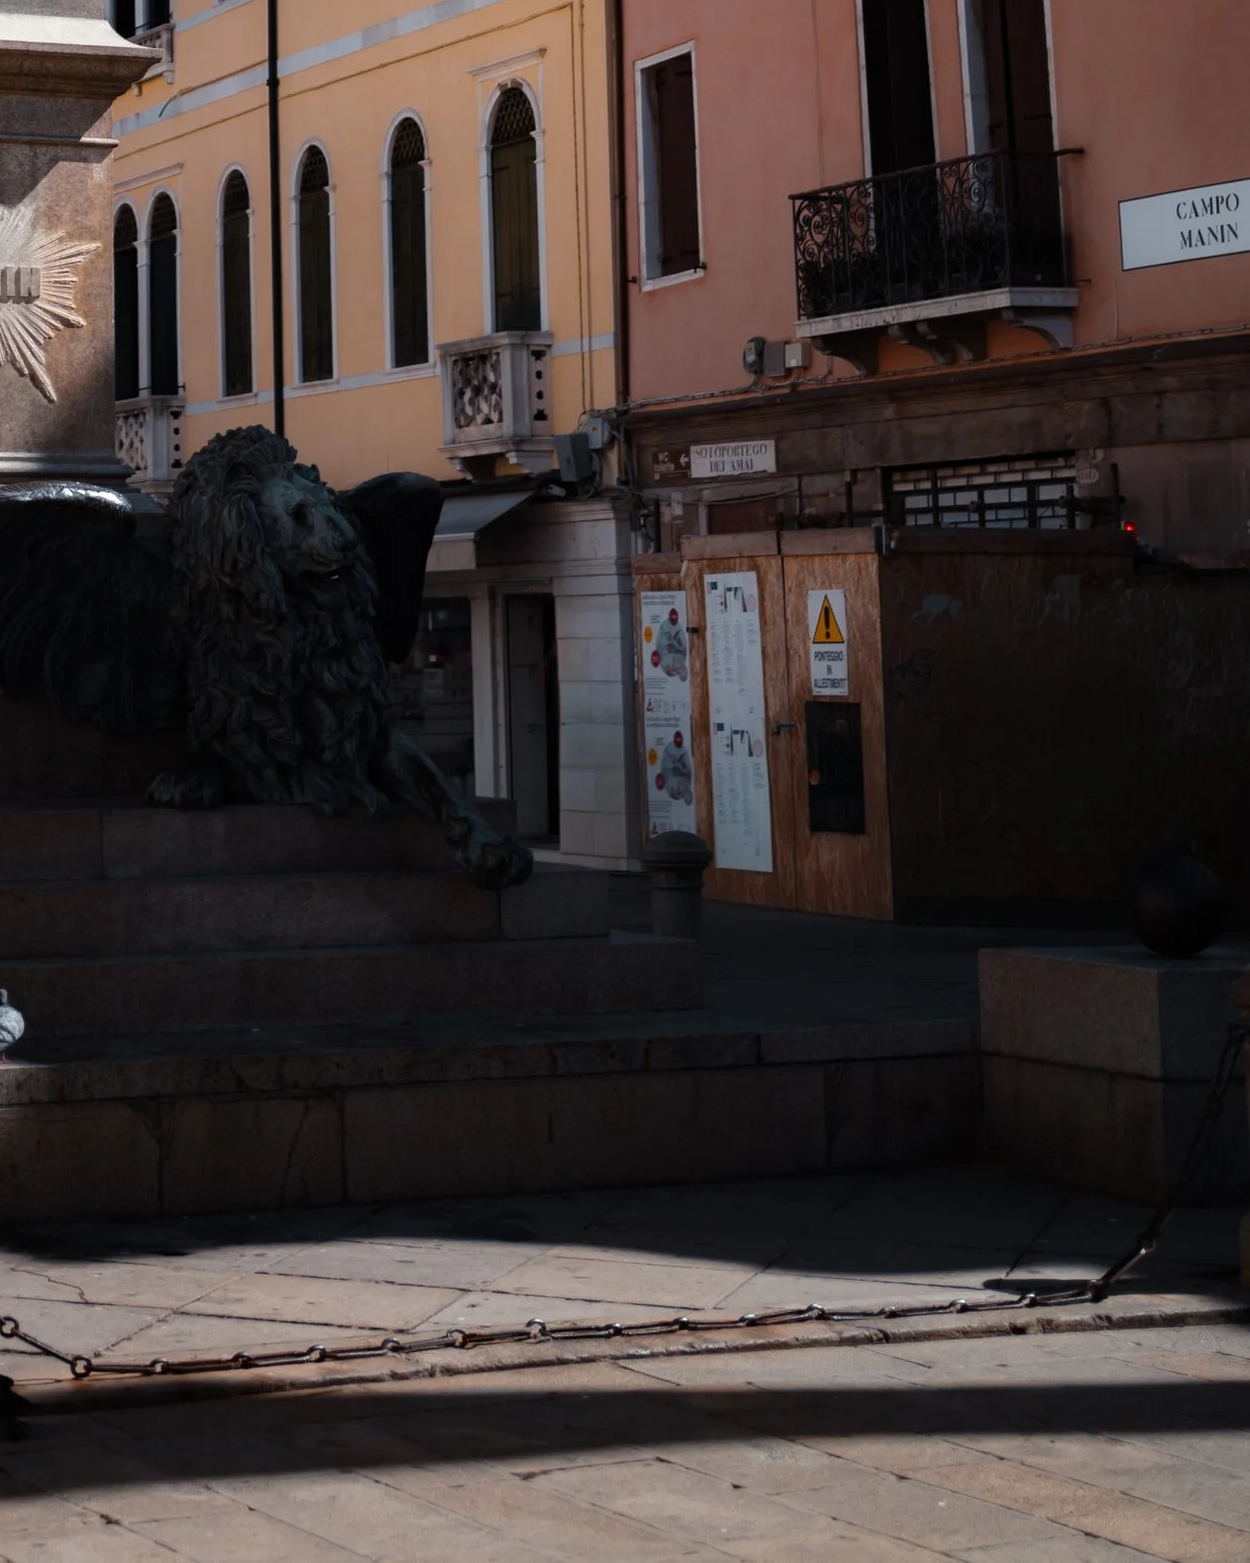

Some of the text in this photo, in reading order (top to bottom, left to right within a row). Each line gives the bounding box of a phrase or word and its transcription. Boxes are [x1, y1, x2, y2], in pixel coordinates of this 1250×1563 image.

[1176, 193, 1239, 220] CAMPO
[1180, 222, 1239, 249] MANIN
[814, 651, 844, 662] PONTEGGIO
